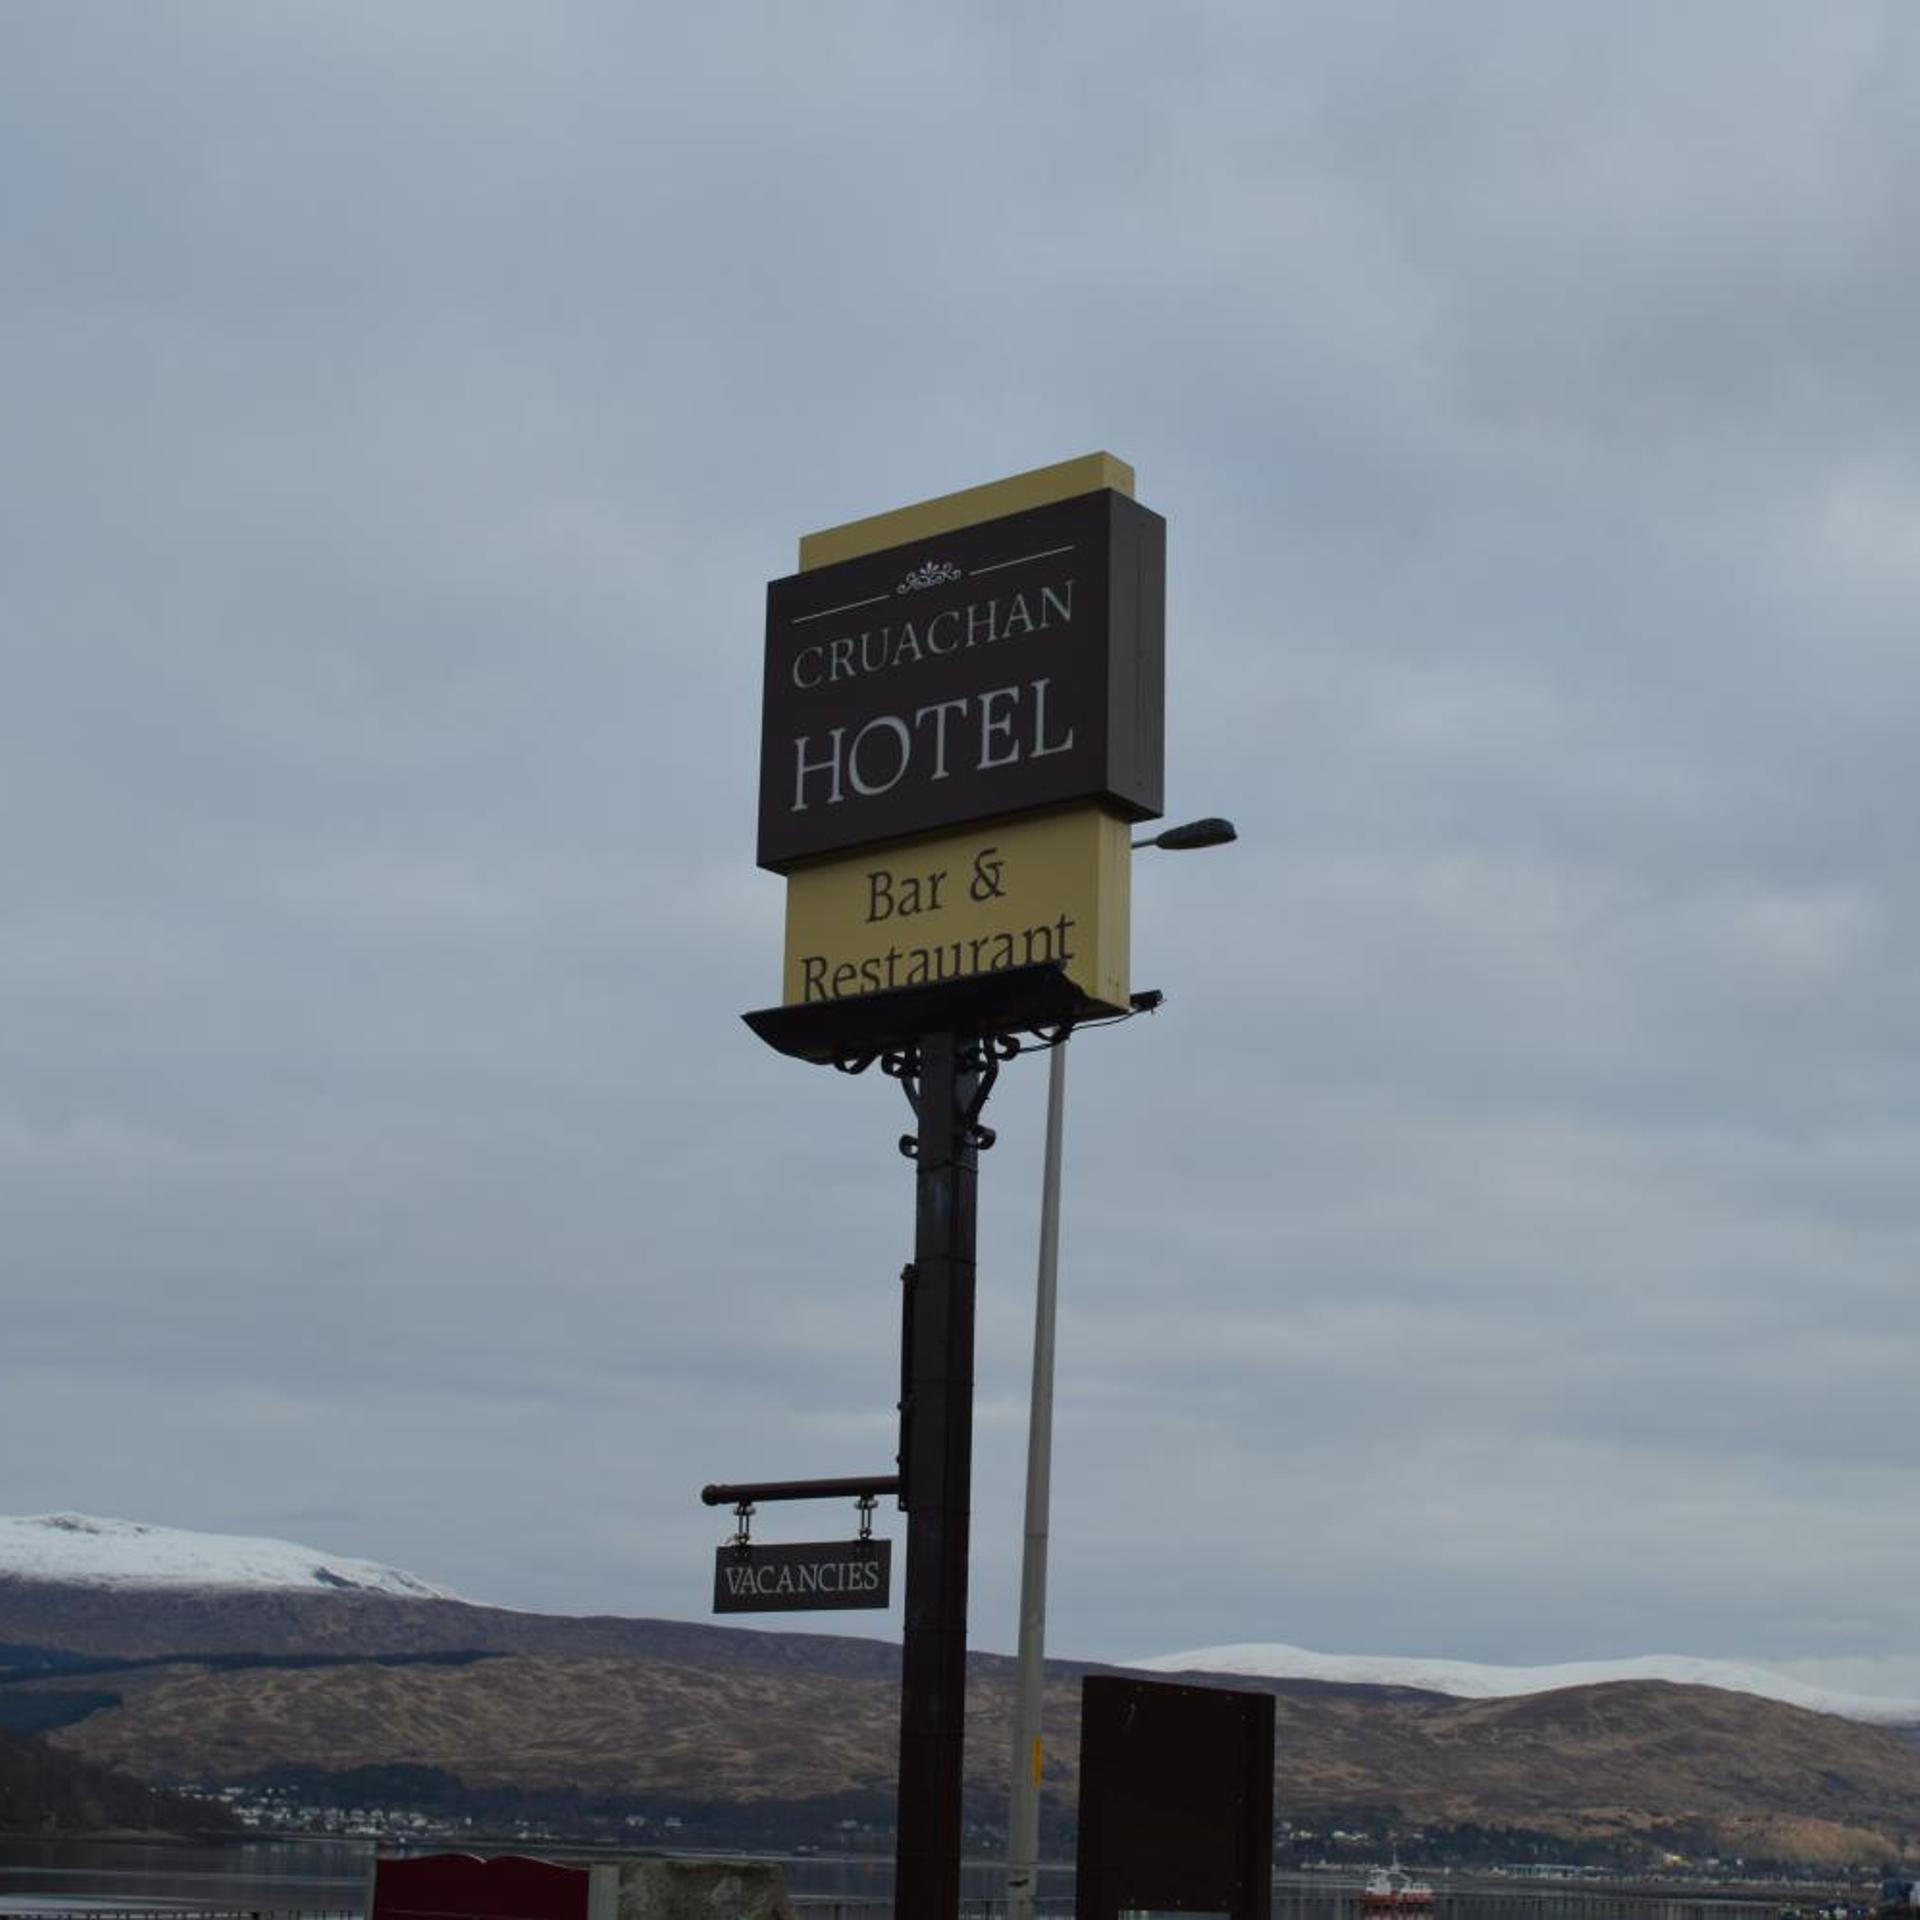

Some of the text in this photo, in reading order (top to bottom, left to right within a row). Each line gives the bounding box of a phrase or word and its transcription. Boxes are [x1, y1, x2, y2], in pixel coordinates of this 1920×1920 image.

[792, 581, 1075, 688] CRUACHAN
[791, 678, 1074, 811] HOTEL
[865, 848, 1006, 923] Bar &
[801, 913, 1075, 1002] Restaurant
[726, 1562, 879, 1595] VACANCIES
